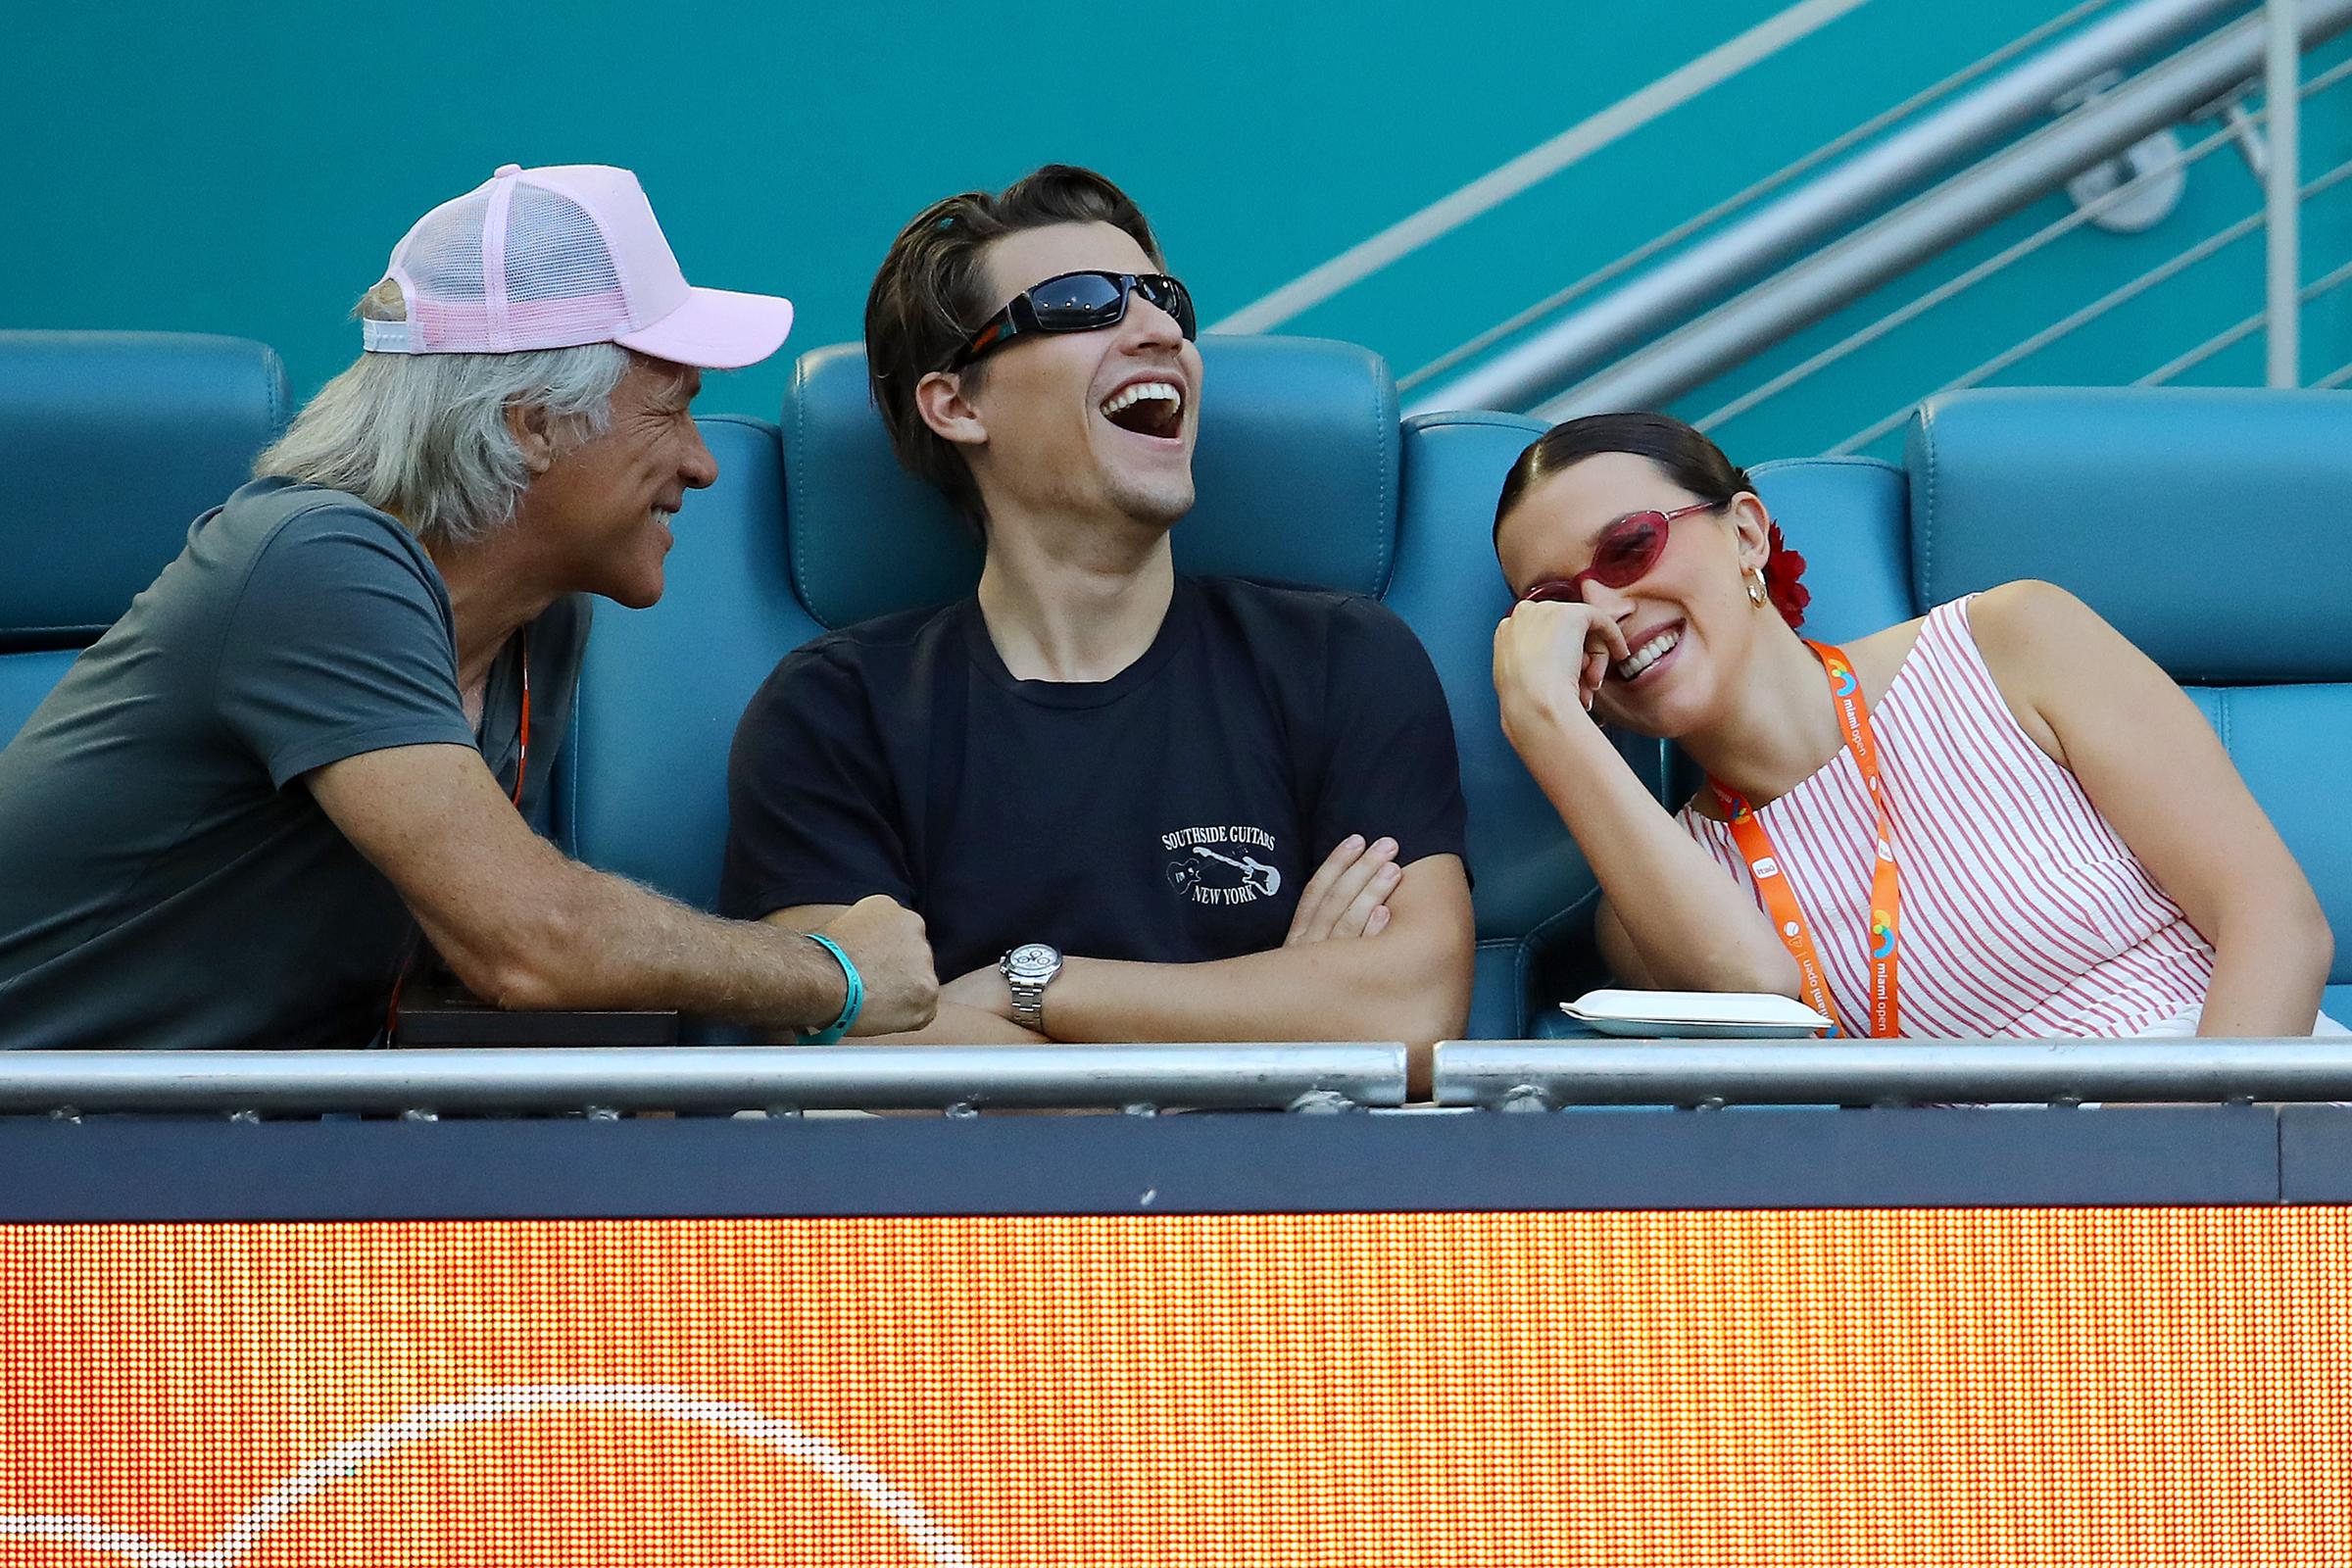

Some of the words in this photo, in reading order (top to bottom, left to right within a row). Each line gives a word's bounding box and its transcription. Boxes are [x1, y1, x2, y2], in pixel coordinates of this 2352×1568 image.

[1842, 698, 1861, 729] miami
[1851, 729, 1867, 757] open
[1161, 825, 1228, 851] SOUTHSIDE
[1229, 825, 1276, 852] GUITARS
[1192, 885, 1221, 905] NEW
[1224, 884, 1257, 906] YORK
[1802, 958, 1819, 988] open
[1877, 962, 1888, 1000] miami
[1876, 1002, 1886, 1032] open
